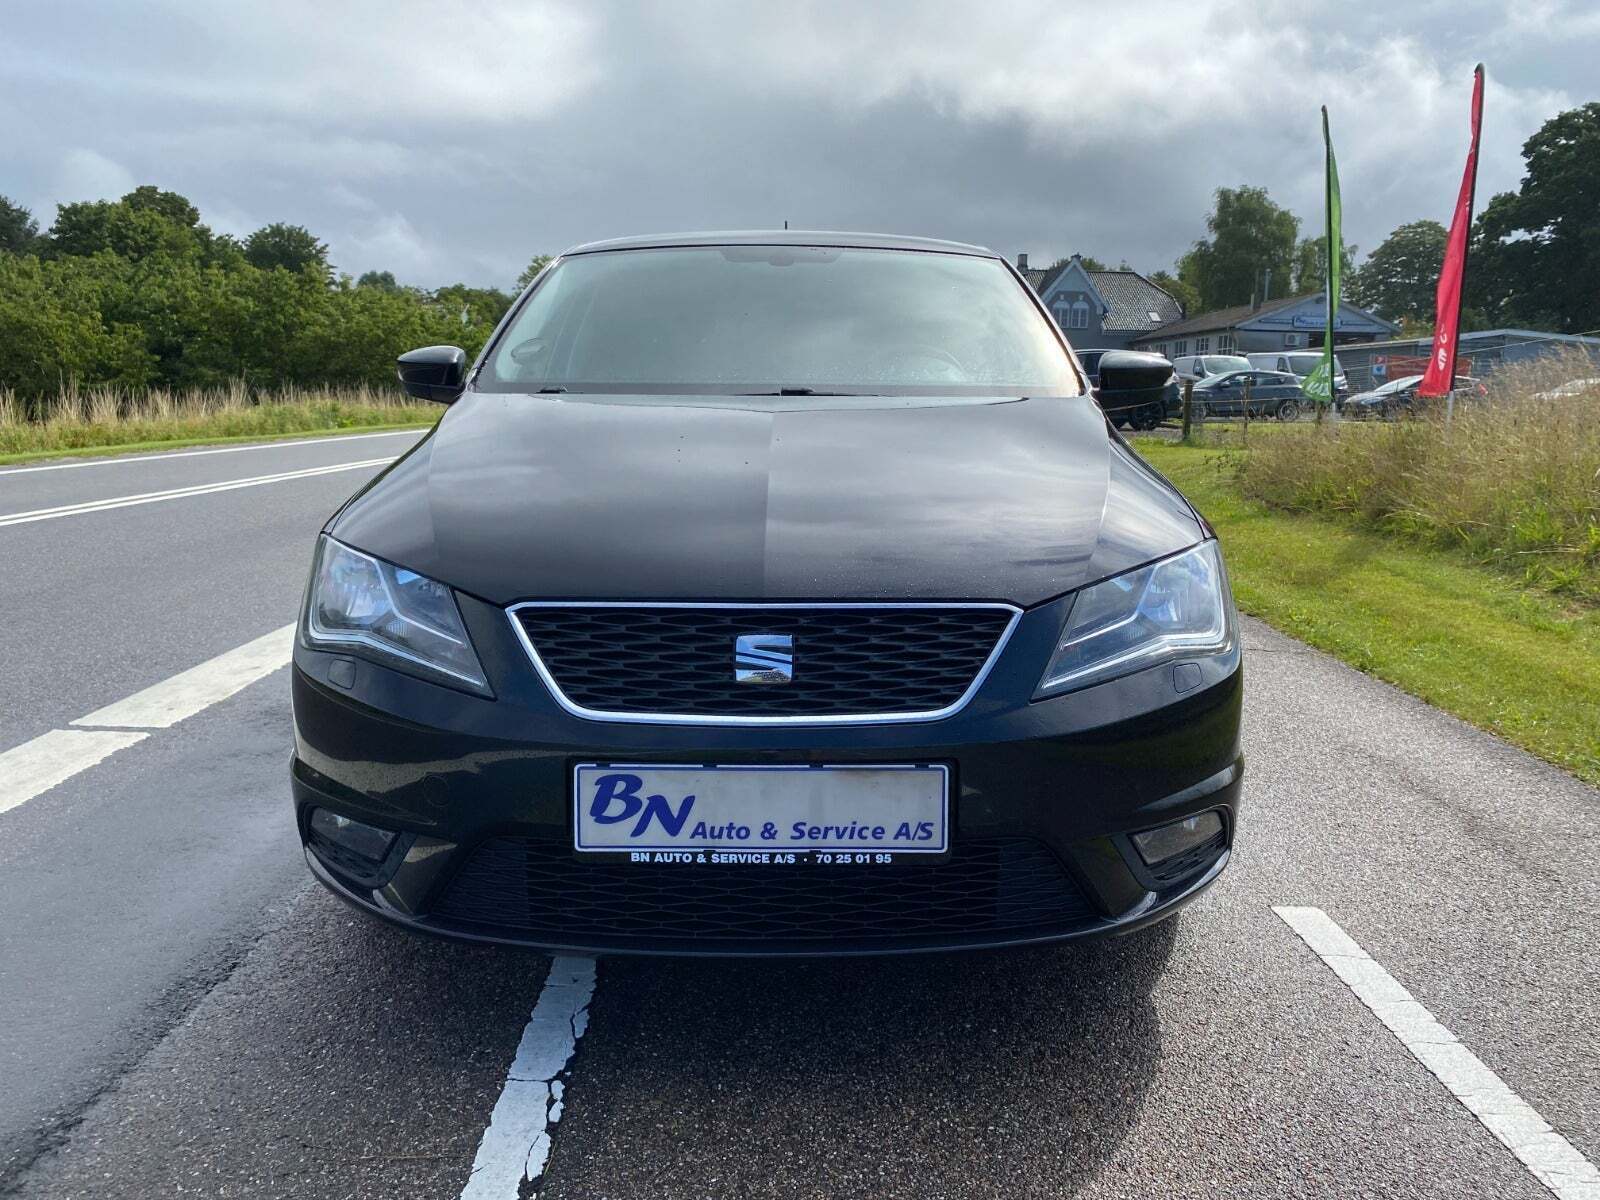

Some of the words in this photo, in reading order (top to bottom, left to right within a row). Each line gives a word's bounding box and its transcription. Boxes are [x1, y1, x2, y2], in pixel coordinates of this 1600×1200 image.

[589, 773, 696, 838] BN
[689, 821, 751, 840] Auto
[760, 821, 779, 840] &
[790, 820, 886, 841] Service
[893, 821, 935, 841] A/S
[630, 852, 650, 863] BN
[654, 852, 692, 863] AUTO
[696, 852, 707, 864] &
[711, 853, 770, 864] SERVICE
[773, 853, 796, 864] A/S
[816, 854, 832, 864] 70
[835, 854, 852, 864] 25
[855, 854, 872, 864] 01
[875, 854, 892, 864] 95
